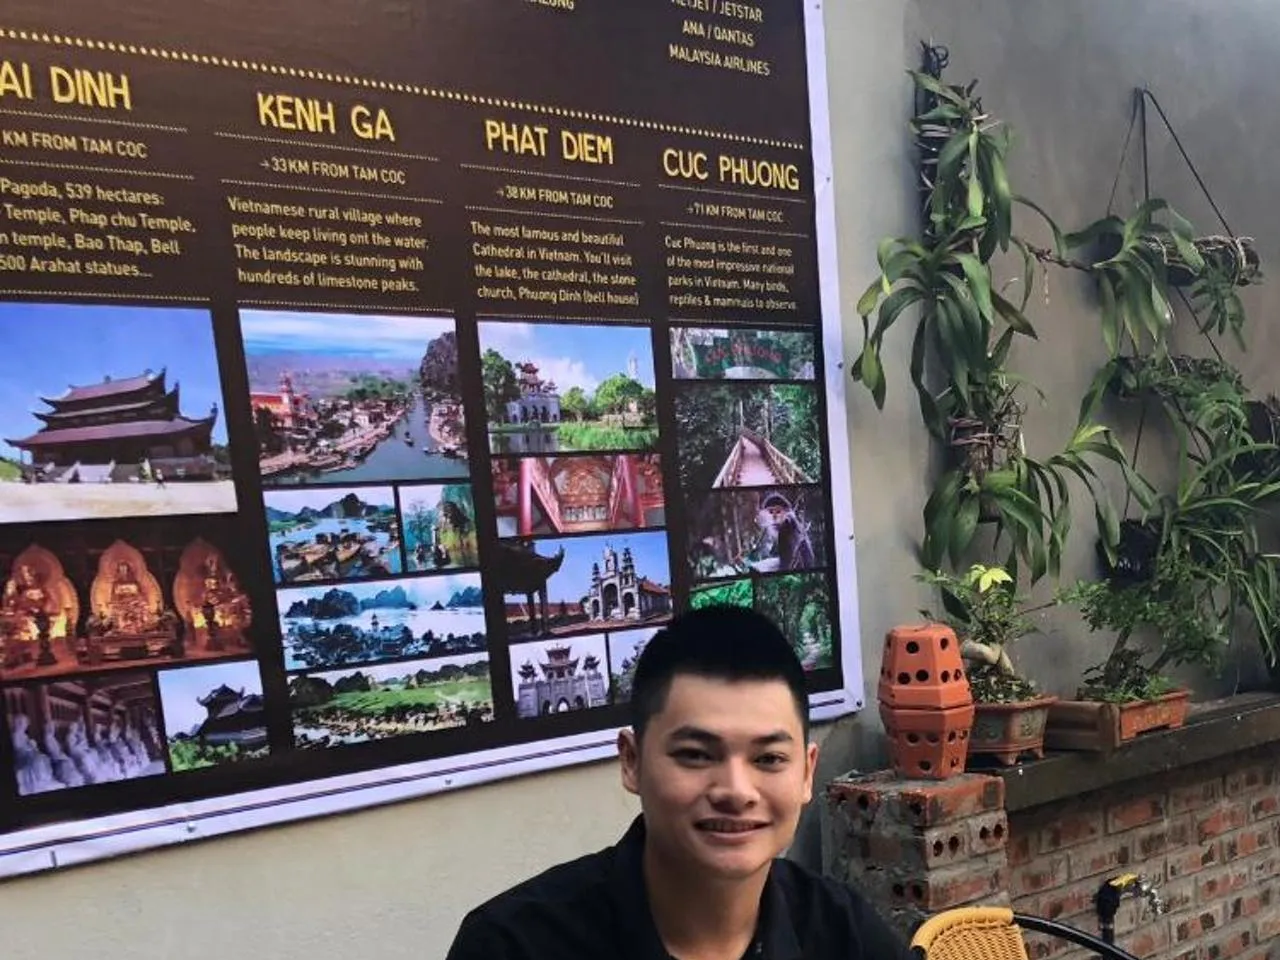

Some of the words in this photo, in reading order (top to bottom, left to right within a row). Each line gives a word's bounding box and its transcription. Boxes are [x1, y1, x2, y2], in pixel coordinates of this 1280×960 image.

[720, 2, 763, 22] JETSTAR
[682, 19, 705, 36] ANA
[713, 26, 755, 47] QANTAS
[669, 43, 722, 67] MALAYSIA
[723, 55, 770, 76] AIRLINES
[0, 60, 33, 100] AI
[50, 66, 132, 110] DINH
[256, 92, 336, 135] KENH
[350, 105, 397, 143] GA
[2, 130, 28, 147] KM
[32, 132, 77, 151] FROM
[81, 137, 114, 155] TAM
[117, 140, 149, 158] COC
[484, 119, 549, 157] PHAT
[561, 130, 615, 165] DIEM
[312, 161, 349, 179] FROM
[353, 165, 378, 182] TAM
[380, 168, 406, 185] COC
[663, 147, 709, 180] CUC
[719, 155, 800, 191] PHUONG
[65, 182, 92, 199] 539
[538, 188, 570, 204] FROM
[571, 192, 592, 206] TAM
[593, 195, 614, 209] COC
[3, 203, 66, 225] Temple,
[69, 207, 109, 229] Phap
[111, 210, 137, 227] chu
[227, 196, 306, 218] Vietnamese
[308, 206, 340, 221] rural
[342, 207, 383, 227] village
[385, 211, 422, 228] where
[721, 206, 746, 218] FROM
[747, 208, 765, 220] TAM
[12, 231, 72, 251] temple,
[74, 233, 104, 250] Bao
[106, 234, 149, 256] Thap,
[150, 238, 181, 255] Bell
[232, 223, 276, 241] people
[279, 225, 311, 243] keep
[312, 228, 348, 247] living
[372, 232, 391, 248] the
[470, 221, 491, 237] The
[493, 225, 520, 239] most
[521, 226, 560, 242] famous
[561, 230, 580, 243] and
[581, 232, 624, 247] beautiful
[665, 235, 682, 249] Cuc
[683, 237, 716, 254] Phuong
[718, 242, 726, 252] is
[726, 241, 741, 253] the
[741, 243, 759, 255] first
[760, 246, 776, 256] and
[777, 248, 793, 257] one
[0, 254, 26, 271] 500
[29, 256, 82, 275] Arahat
[234, 243, 260, 260] The
[262, 246, 328, 265] landscape
[330, 251, 342, 266] is
[344, 251, 396, 272] stunning
[399, 256, 425, 271] with
[472, 242, 525, 259] Cathedral
[527, 247, 537, 260] in
[538, 248, 583, 263] Vietnam.
[612, 255, 633, 267] visit
[677, 256, 692, 268] the
[692, 259, 715, 269] most
[716, 260, 761, 275] impressive
[238, 268, 300, 286] hundreds
[302, 272, 315, 286] of
[316, 273, 379, 291] limestone
[381, 278, 420, 293] peaks.
[474, 264, 492, 278] the
[494, 265, 522, 280] lake,
[522, 267, 539, 280] the
[541, 268, 592, 284] cathedral,
[592, 272, 609, 285] the
[610, 274, 637, 286] stone
[668, 275, 694, 288] parks
[694, 277, 704, 287] in
[743, 278, 765, 293] Many
[477, 285, 517, 301] church,
[518, 286, 557, 304] Phuong
[559, 289, 583, 302] Dinh
[669, 294, 703, 307] reptiles
[704, 295, 711, 306] &
[713, 297, 754, 309] mammals
[755, 299, 764, 309] to
